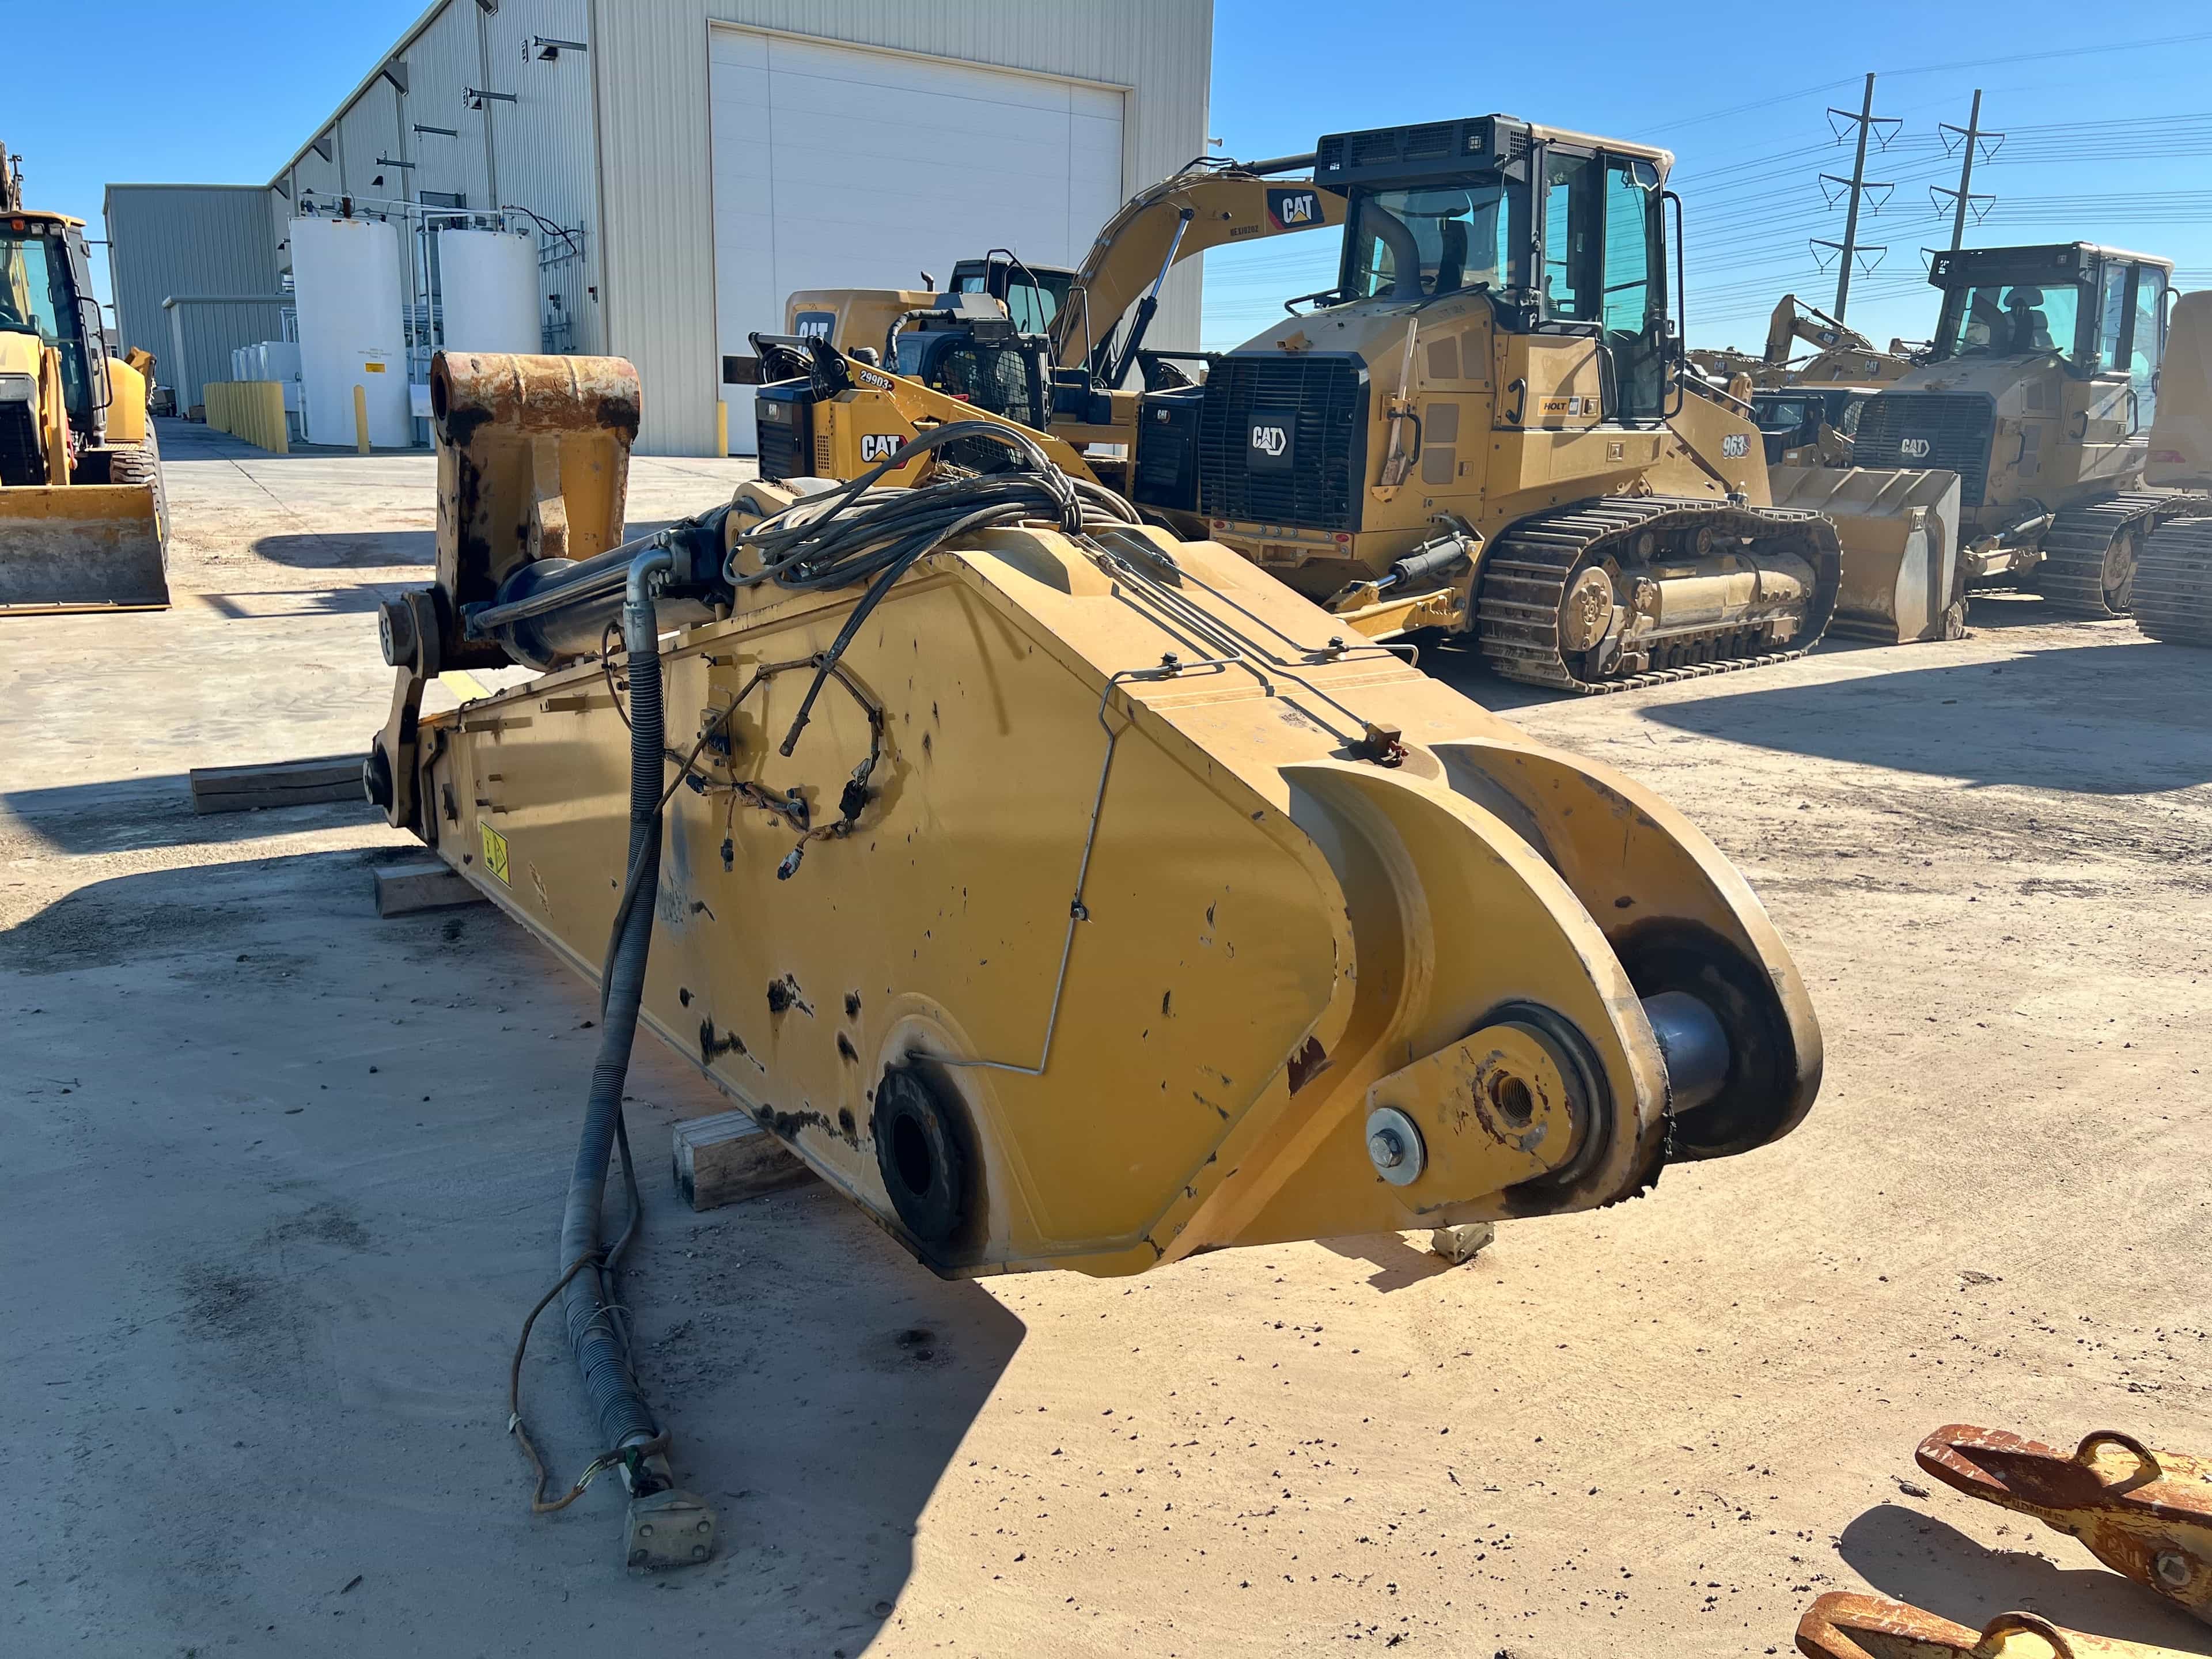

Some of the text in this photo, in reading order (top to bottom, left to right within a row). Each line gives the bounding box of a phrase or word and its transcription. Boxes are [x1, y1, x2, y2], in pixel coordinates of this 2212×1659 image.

[1283, 195, 1313, 224] CAT
[799, 321, 828, 355] CAT
[1865, 360, 1878, 372] CAT
[859, 370, 889, 389] 299D3
[1157, 410, 1168, 419] CAT
[862, 435, 899, 461] CAT
[1252, 426, 1282, 450] CAT
[1723, 435, 1744, 456] 963
[1902, 438, 1927, 453] CAT
